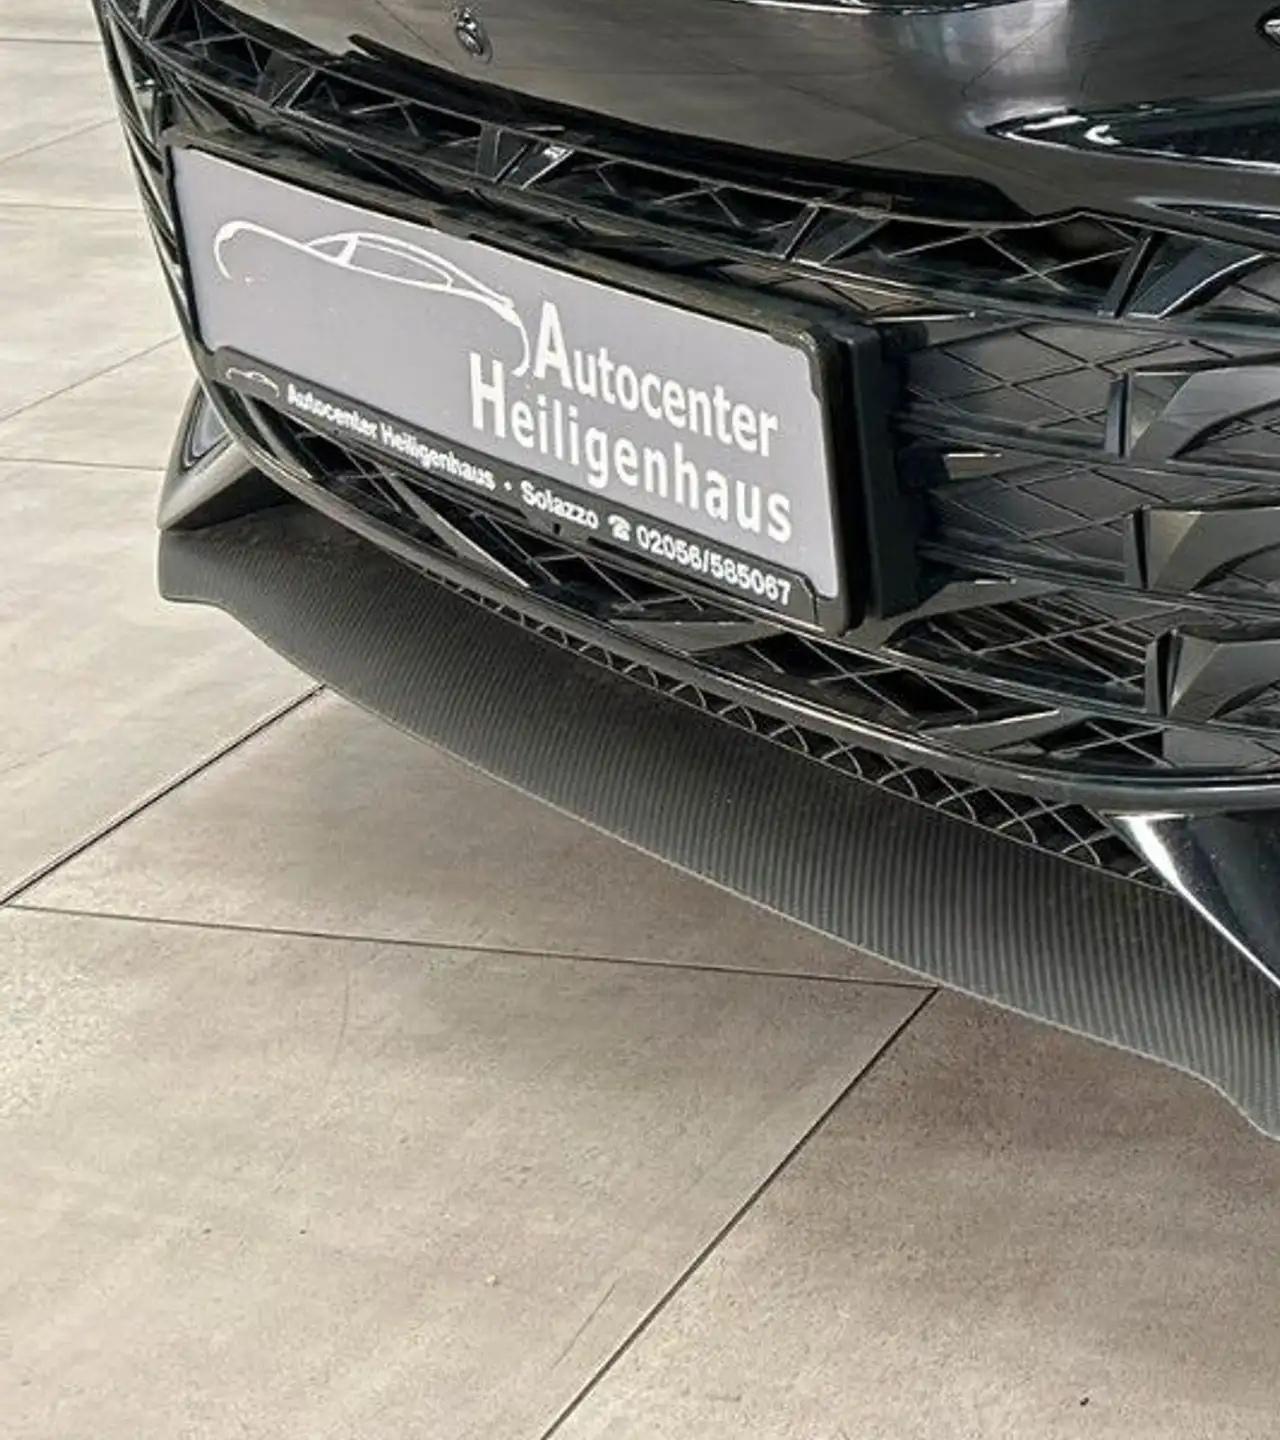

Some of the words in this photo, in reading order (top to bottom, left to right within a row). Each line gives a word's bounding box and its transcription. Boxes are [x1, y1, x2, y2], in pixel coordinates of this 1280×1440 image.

[287, 382, 378, 440] Autocenter
[379, 421, 496, 491] Heiligenhaus
[520, 479, 599, 530] Solazzo
[469, 351, 793, 544] Heiligenhaus
[533, 299, 778, 458] Autocenter
